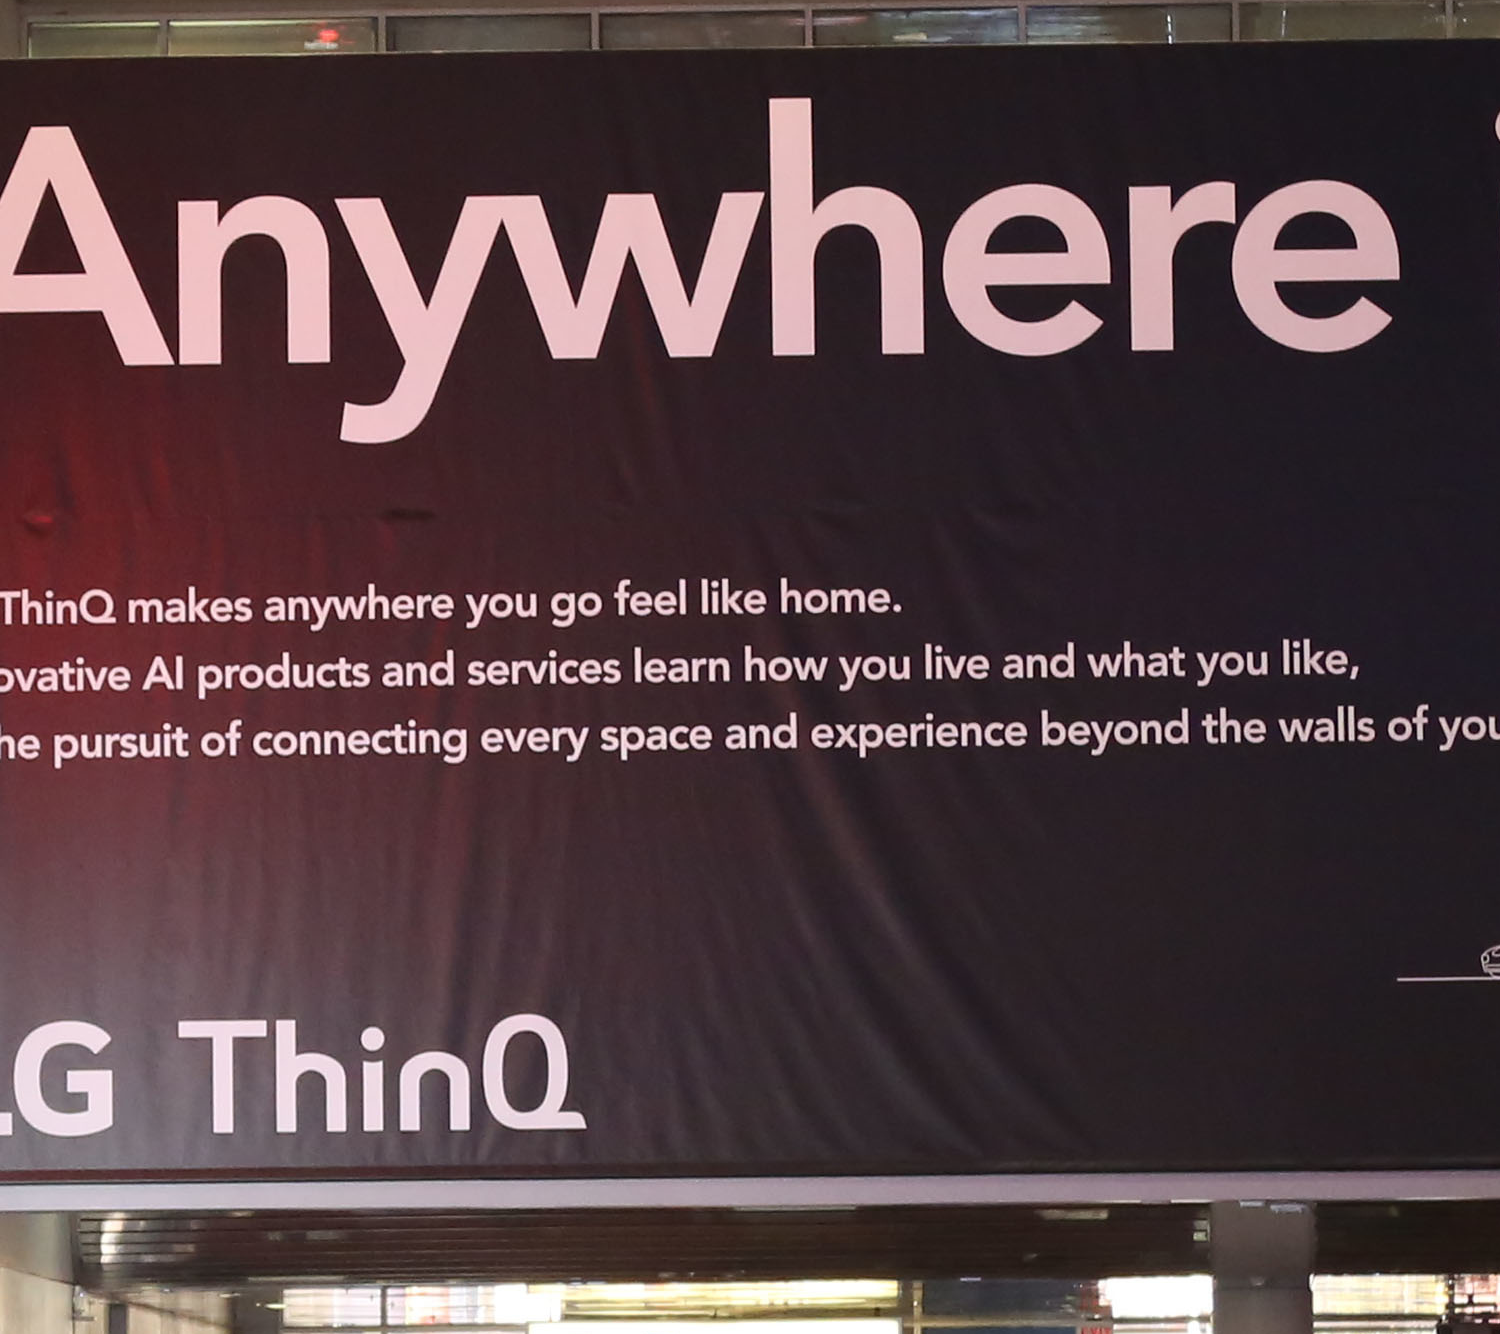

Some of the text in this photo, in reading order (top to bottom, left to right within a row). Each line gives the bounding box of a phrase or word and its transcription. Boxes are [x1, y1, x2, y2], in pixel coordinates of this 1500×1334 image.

[128, 585, 253, 624] makes
[264, 583, 455, 632] anywhere
[465, 593, 538, 629] you
[550, 592, 603, 628] go
[613, 578, 687, 616] feel
[701, 578, 767, 615] like
[780, 577, 902, 614] home.
[142, 655, 184, 691] AI
[198, 651, 371, 700] products
[381, 649, 455, 688] and
[467, 649, 622, 686] services
[634, 646, 731, 684] learn
[744, 645, 829, 682] how
[838, 655, 911, 692] you
[924, 643, 990, 680] live
[1002, 641, 1075, 680] and
[1086, 640, 1186, 678] what
[1196, 651, 1269, 687] you
[1282, 638, 1359, 680] like,
[54, 722, 189, 769] pursuit
[200, 719, 242, 757] of
[252, 719, 467, 764] connecting
[480, 727, 590, 762] every
[600, 725, 713, 761] space
[725, 711, 798, 750] and
[811, 712, 1028, 759] experience
[1041, 707, 1189, 756] beyond
[1201, 706, 1267, 744] the
[1278, 705, 1376, 743] walls
[1387, 703, 1429, 742] of
[177, 1013, 587, 1134] ThinQ
